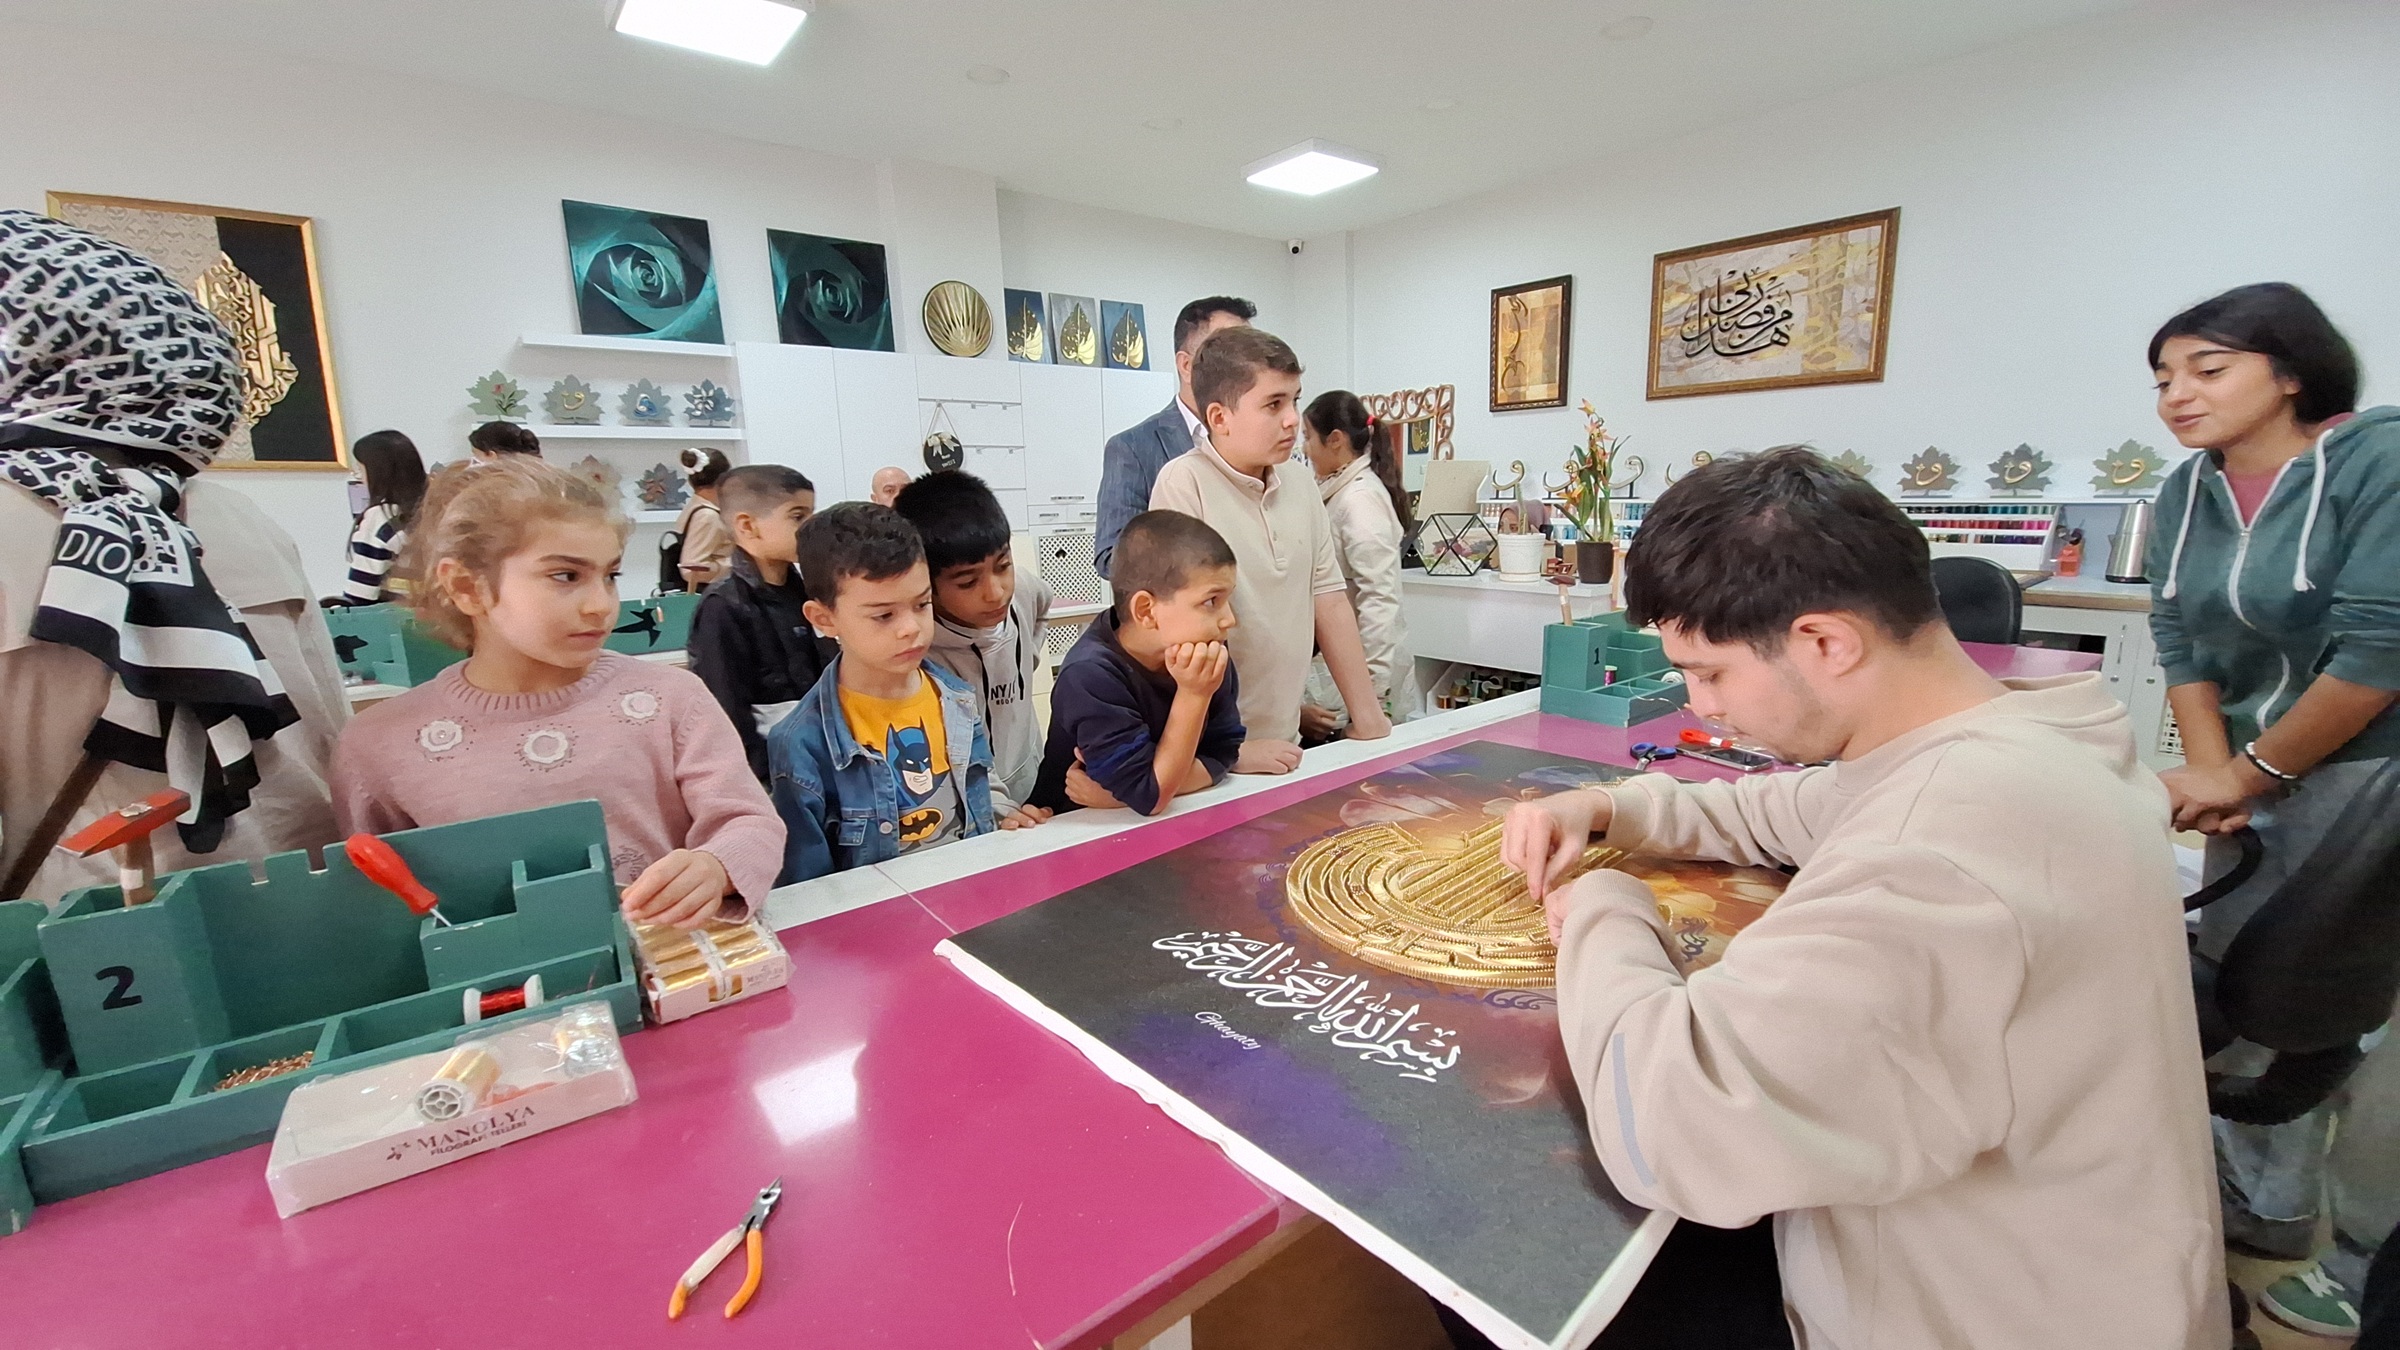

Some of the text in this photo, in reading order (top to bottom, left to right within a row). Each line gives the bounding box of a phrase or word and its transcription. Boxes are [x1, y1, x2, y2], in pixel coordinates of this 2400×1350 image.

[56, 528, 134, 584] DIO
[1593, 647, 1600, 665] 1
[95, 965, 143, 1010] 2
[416, 1105, 536, 1150] MANOLYA
